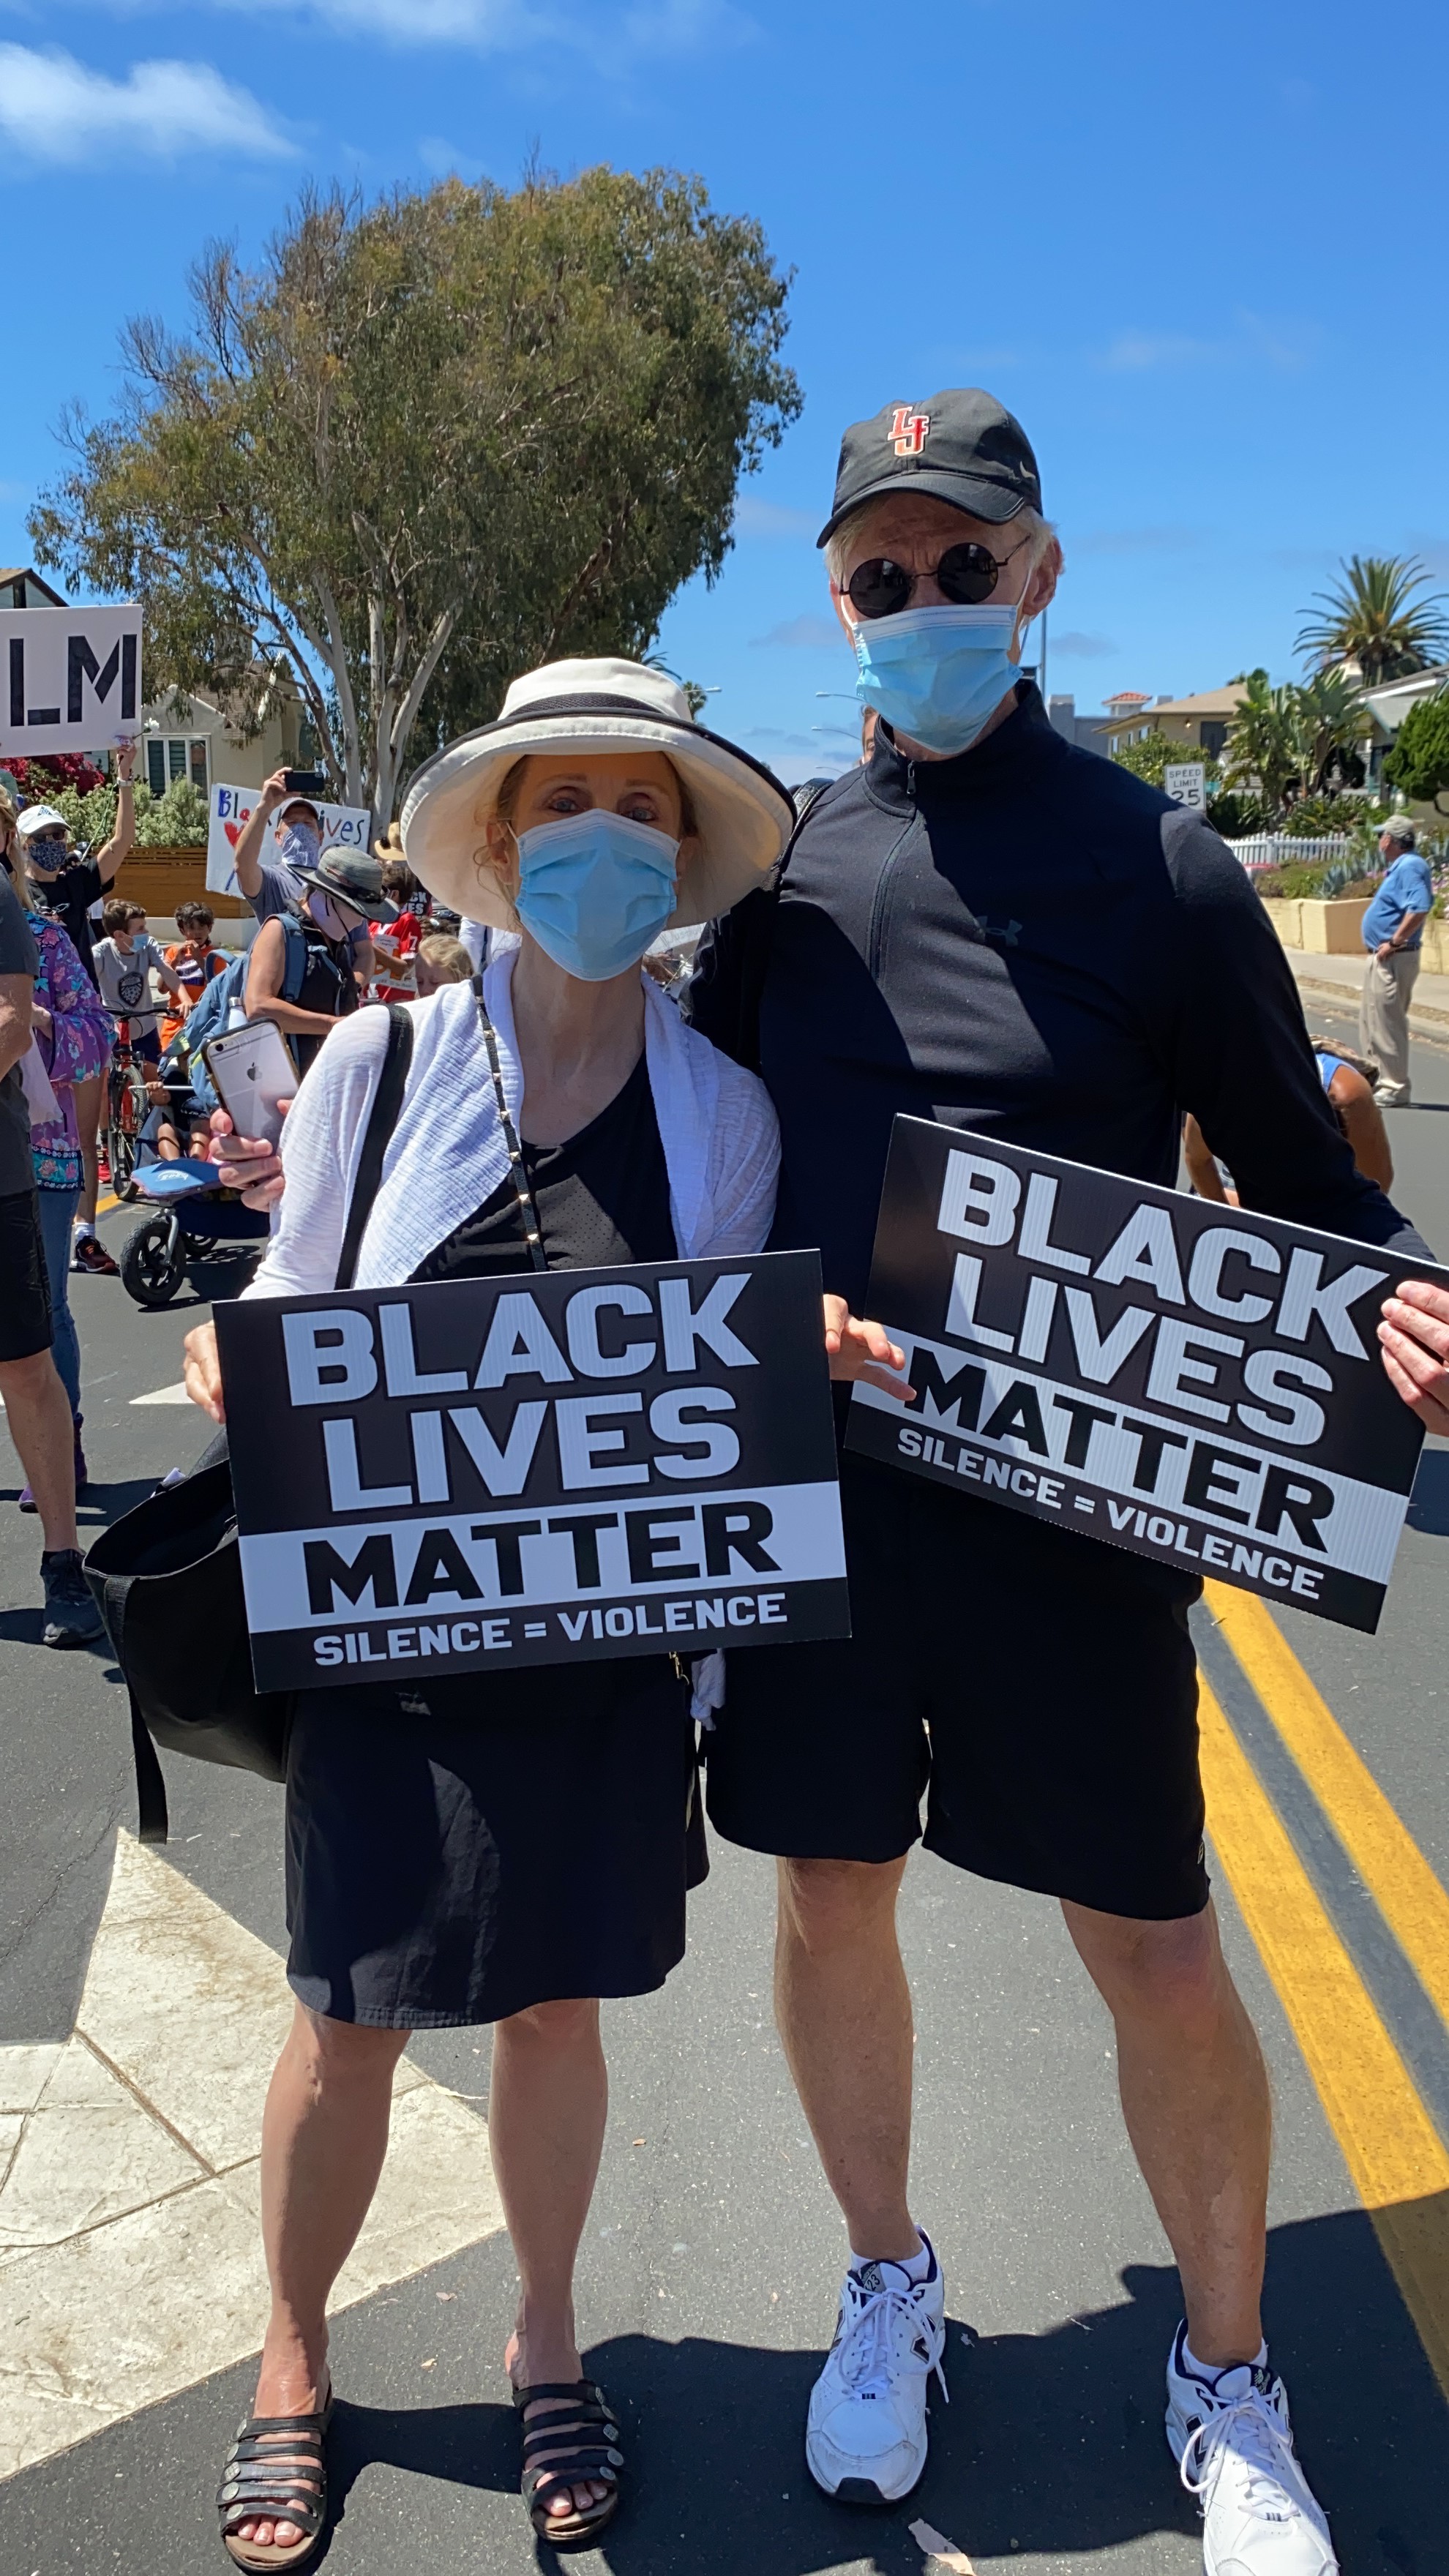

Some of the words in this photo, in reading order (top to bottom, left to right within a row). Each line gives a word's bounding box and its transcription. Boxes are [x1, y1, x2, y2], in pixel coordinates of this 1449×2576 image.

[1169, 768, 1202, 779] SPEED
[1171, 788, 1201, 806] 25
[1173, 779, 1198, 788] LIMIT
[937, 1148, 1390, 1361] BLACK
[281, 1273, 760, 1407] BLACK
[944, 1252, 1335, 1446] LIVES
[322, 1386, 740, 1512] LIVES
[904, 1345, 1335, 1554] MATTER
[302, 1500, 782, 1615] MATTER
[897, 1429, 1066, 1510] SILENCE
[1107, 1499, 1325, 1600] VIOLENCE
[313, 1618, 512, 1666] SILENCE
[556, 1592, 787, 1641] VIOLENCE
[864, 2274, 880, 2291] 23
